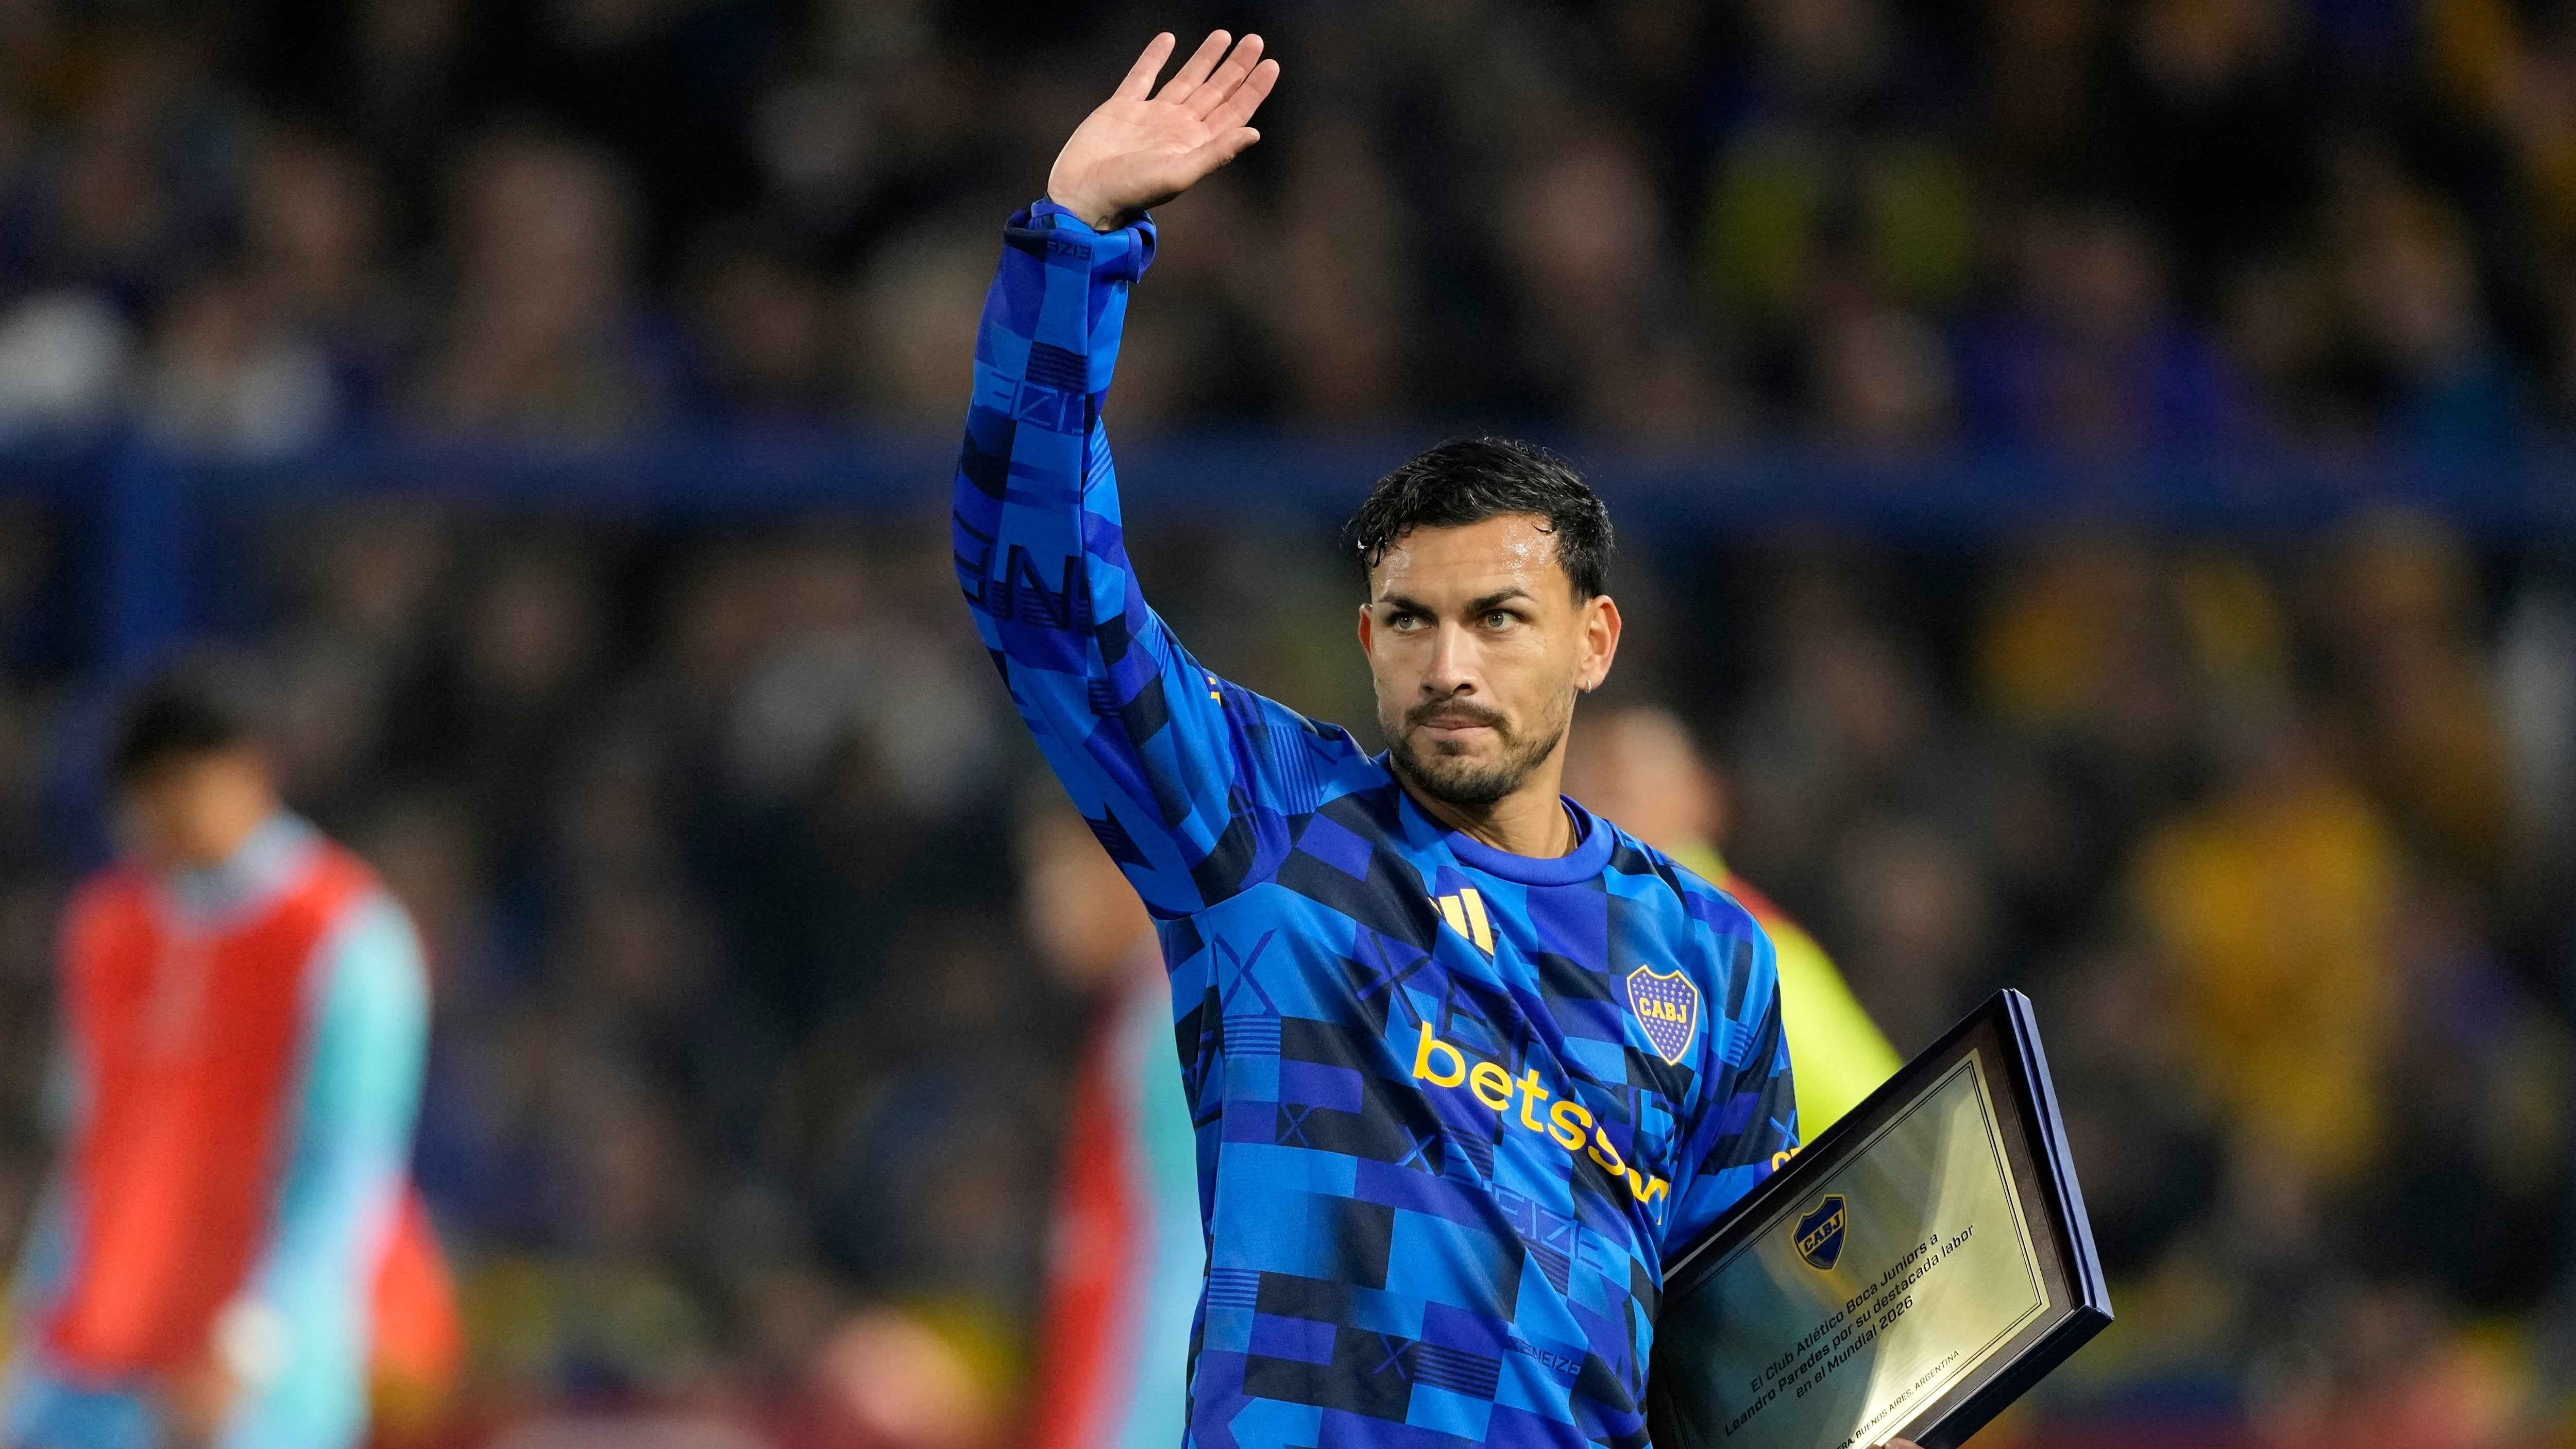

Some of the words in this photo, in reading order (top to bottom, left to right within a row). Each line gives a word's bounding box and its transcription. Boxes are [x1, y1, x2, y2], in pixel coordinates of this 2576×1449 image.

[1639, 997, 1687, 1023] CABJ
[1804, 1213, 1840, 1252] CABJ
[1724, 1389, 1776, 1437] Leandro
[1778, 1345, 1830, 1392] Paredes
[1832, 1324, 1856, 1350] por
[1855, 1309, 1872, 1328] su
[1873, 1254, 1940, 1314] destacada
[1941, 1224, 1974, 1258] labor
[1751, 1375, 1764, 1393] El
[1766, 1352, 1794, 1381] Club
[1797, 1311, 1844, 1357] Atlético
[1846, 1283, 1878, 1315] Boca
[1880, 1242, 1927, 1287] Juniors
[1930, 1234, 1938, 1245] a
[1796, 1380, 1812, 1399] en
[1815, 1366, 1826, 1381] el
[1828, 1324, 1877, 1374] Mundial
[1879, 1295, 1914, 1330] 2026
[1856, 1409, 1888, 1439] BUENOS
[1889, 1389, 1914, 1412] AIRES,
[1916, 1350, 1960, 1391] ARGENTINA
